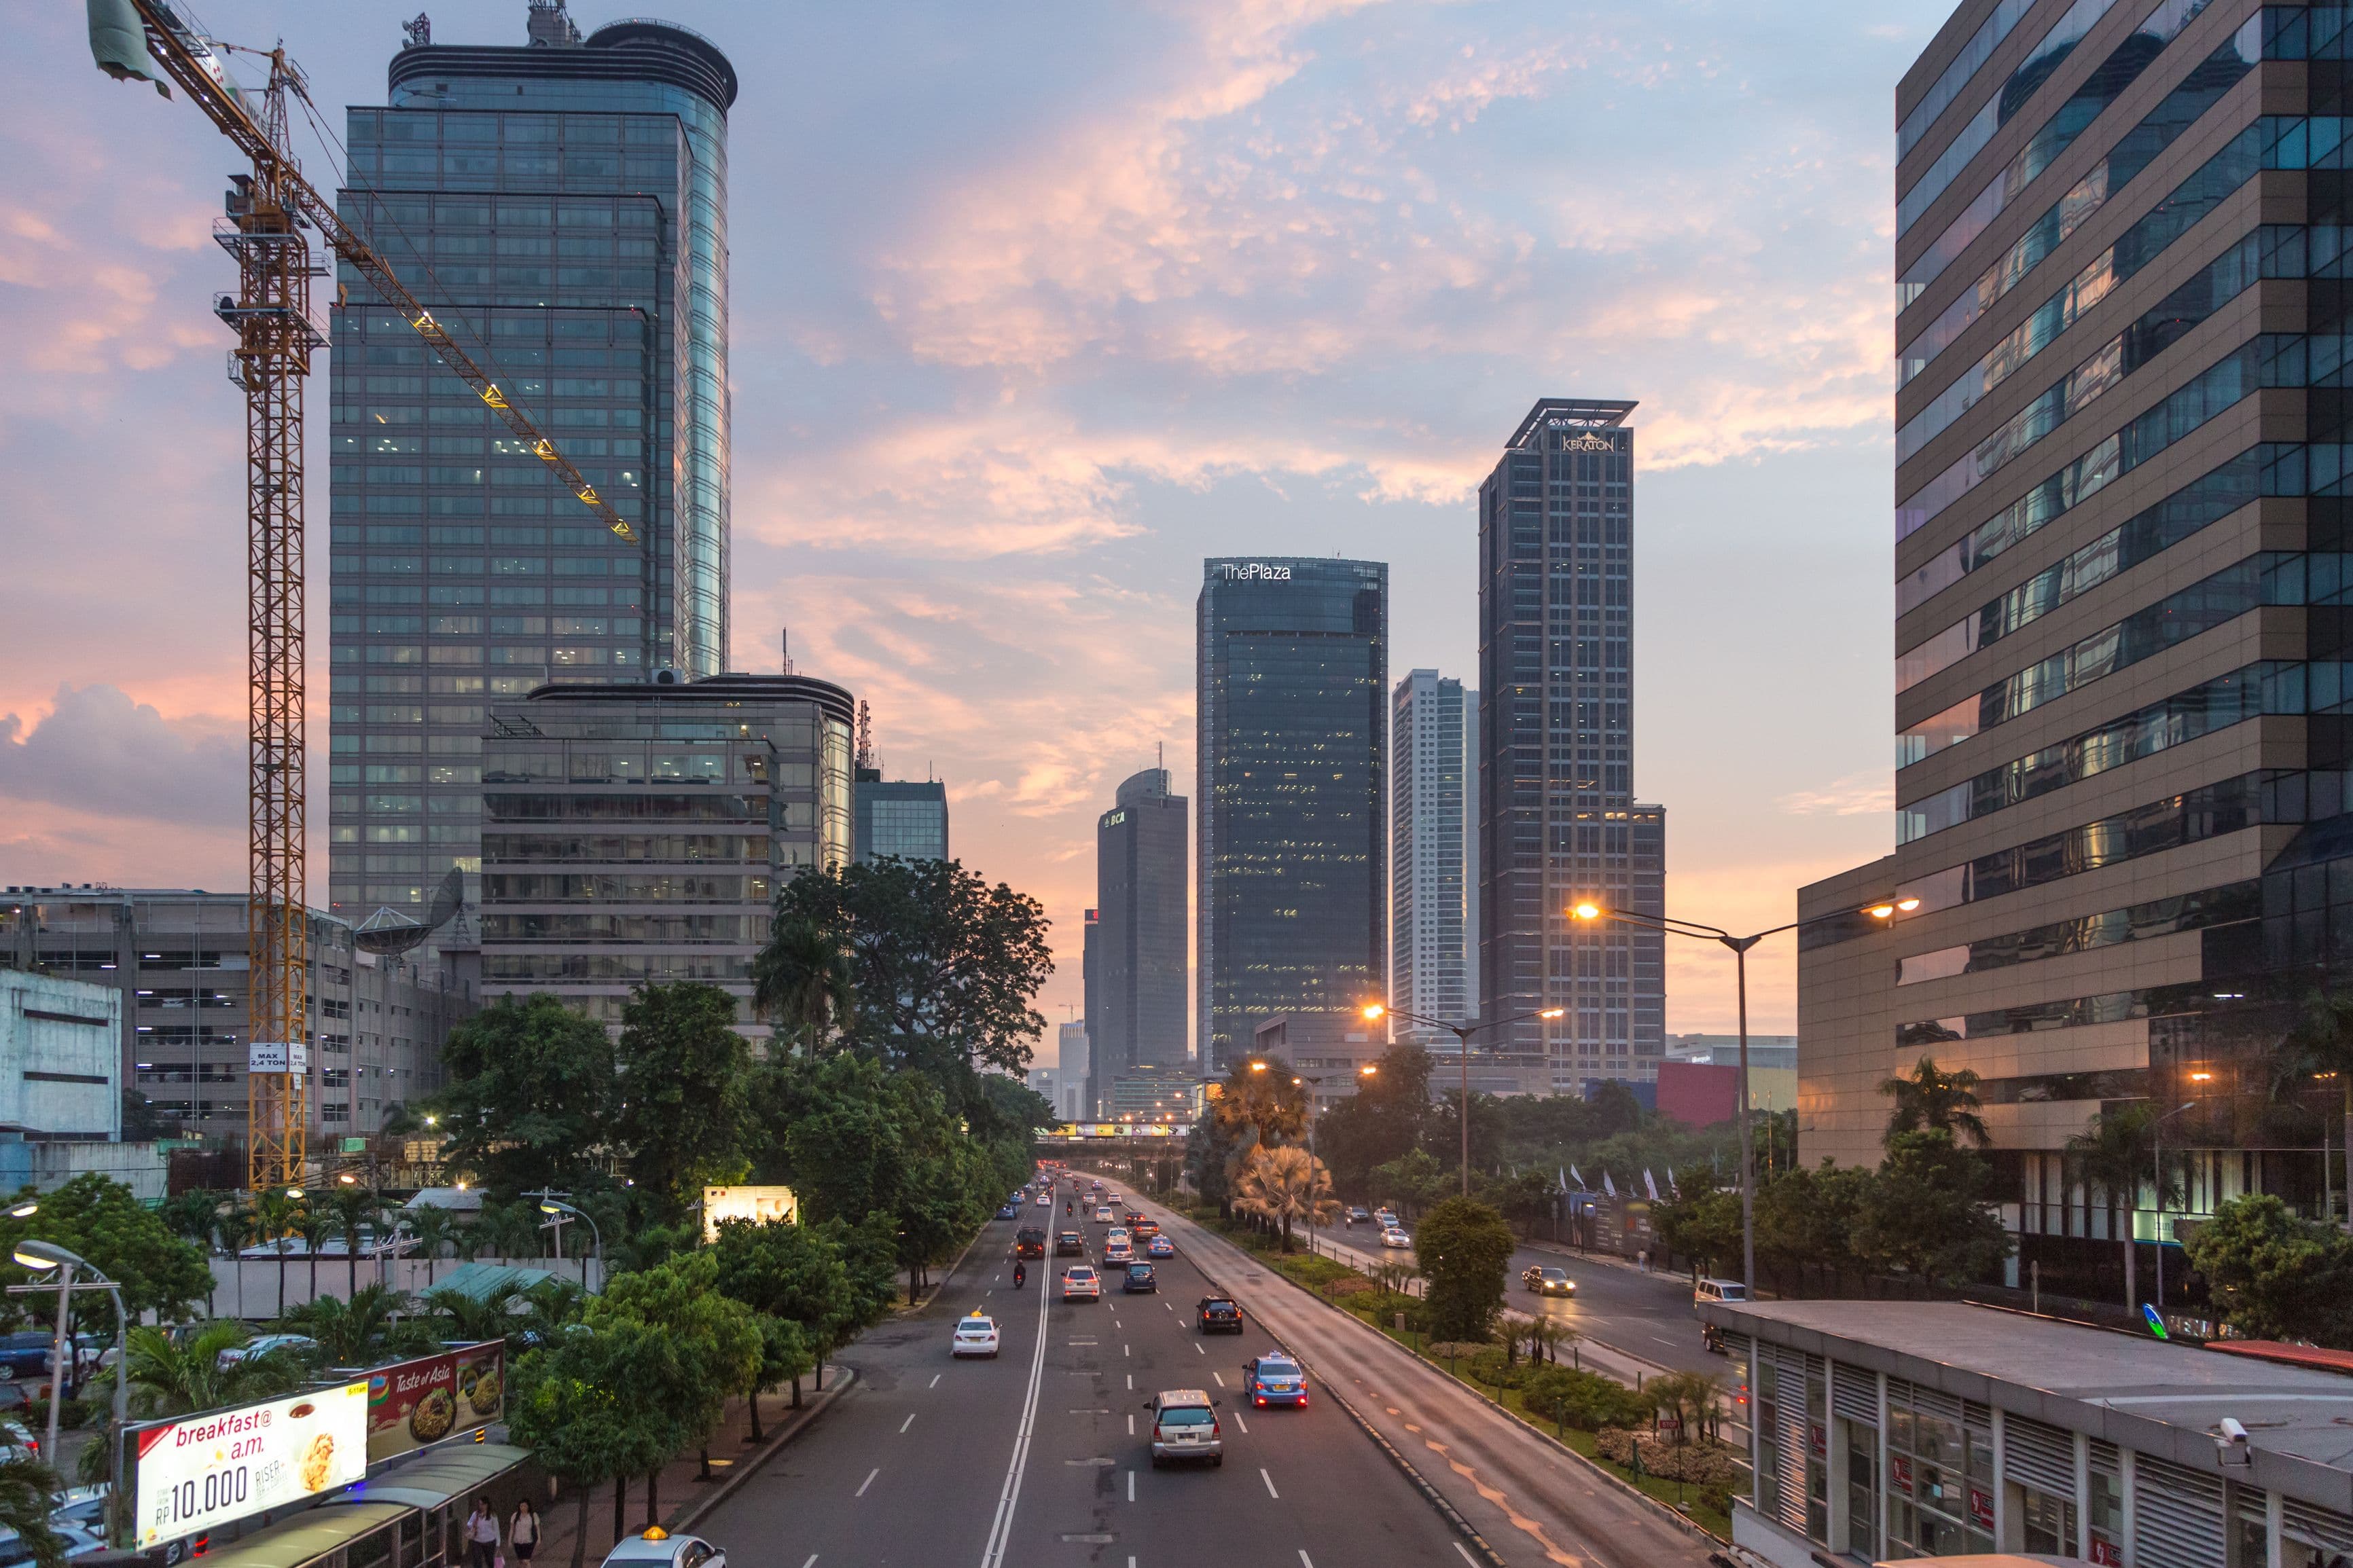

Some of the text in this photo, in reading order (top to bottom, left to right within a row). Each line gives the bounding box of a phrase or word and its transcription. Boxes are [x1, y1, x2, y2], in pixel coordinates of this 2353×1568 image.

[1563, 435, 1614, 452] KERATON
[1111, 812, 1125, 826] BCA
[396, 1372, 419, 1393] Taste
[420, 1371, 430, 1385] of
[429, 1364, 450, 1385] Asia
[231, 1436, 264, 1459] a.m.
[255, 1460, 280, 1487] RISER
[156, 1465, 247, 1526] RP 10.000
